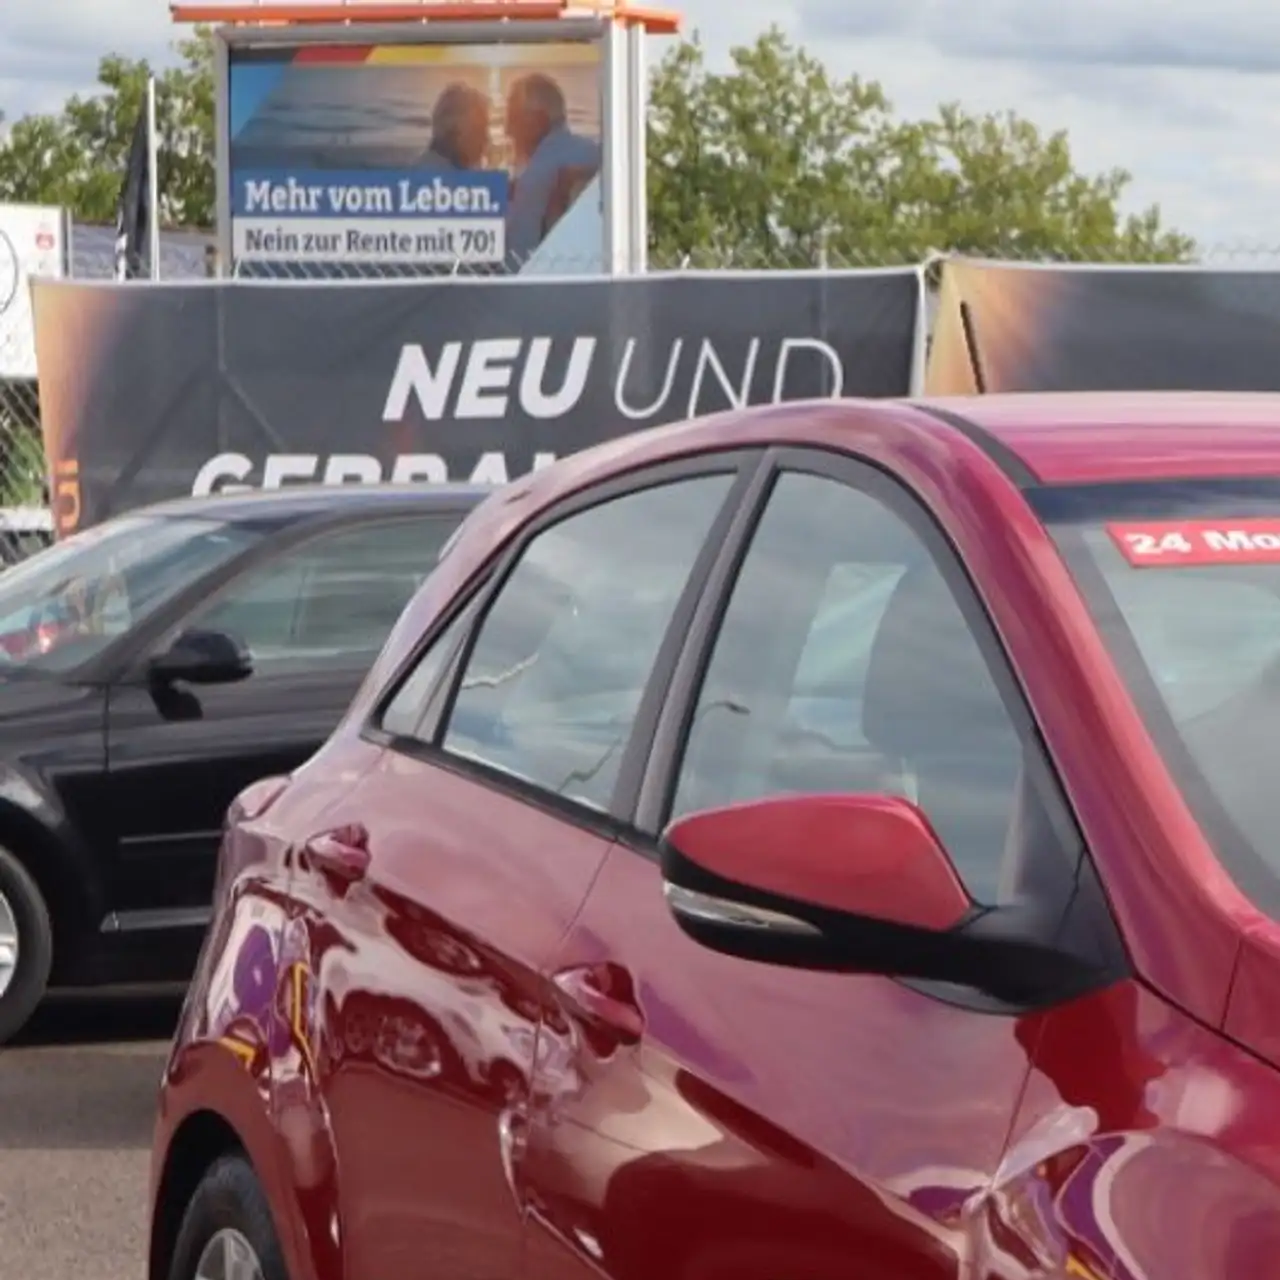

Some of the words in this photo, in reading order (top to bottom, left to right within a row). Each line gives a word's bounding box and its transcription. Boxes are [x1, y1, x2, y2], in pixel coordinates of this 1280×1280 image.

[244, 176, 323, 213] Mehr
[328, 184, 393, 213] vom
[398, 177, 500, 213] Leben.
[244, 227, 299, 252] Nein
[303, 231, 342, 252] zur
[345, 229, 412, 252] Rente
[416, 228, 456, 252] mit
[460, 229, 496, 255] 70!
[382, 336, 597, 422] NEU
[613, 337, 844, 419] UND
[1125, 530, 1193, 555] 24
